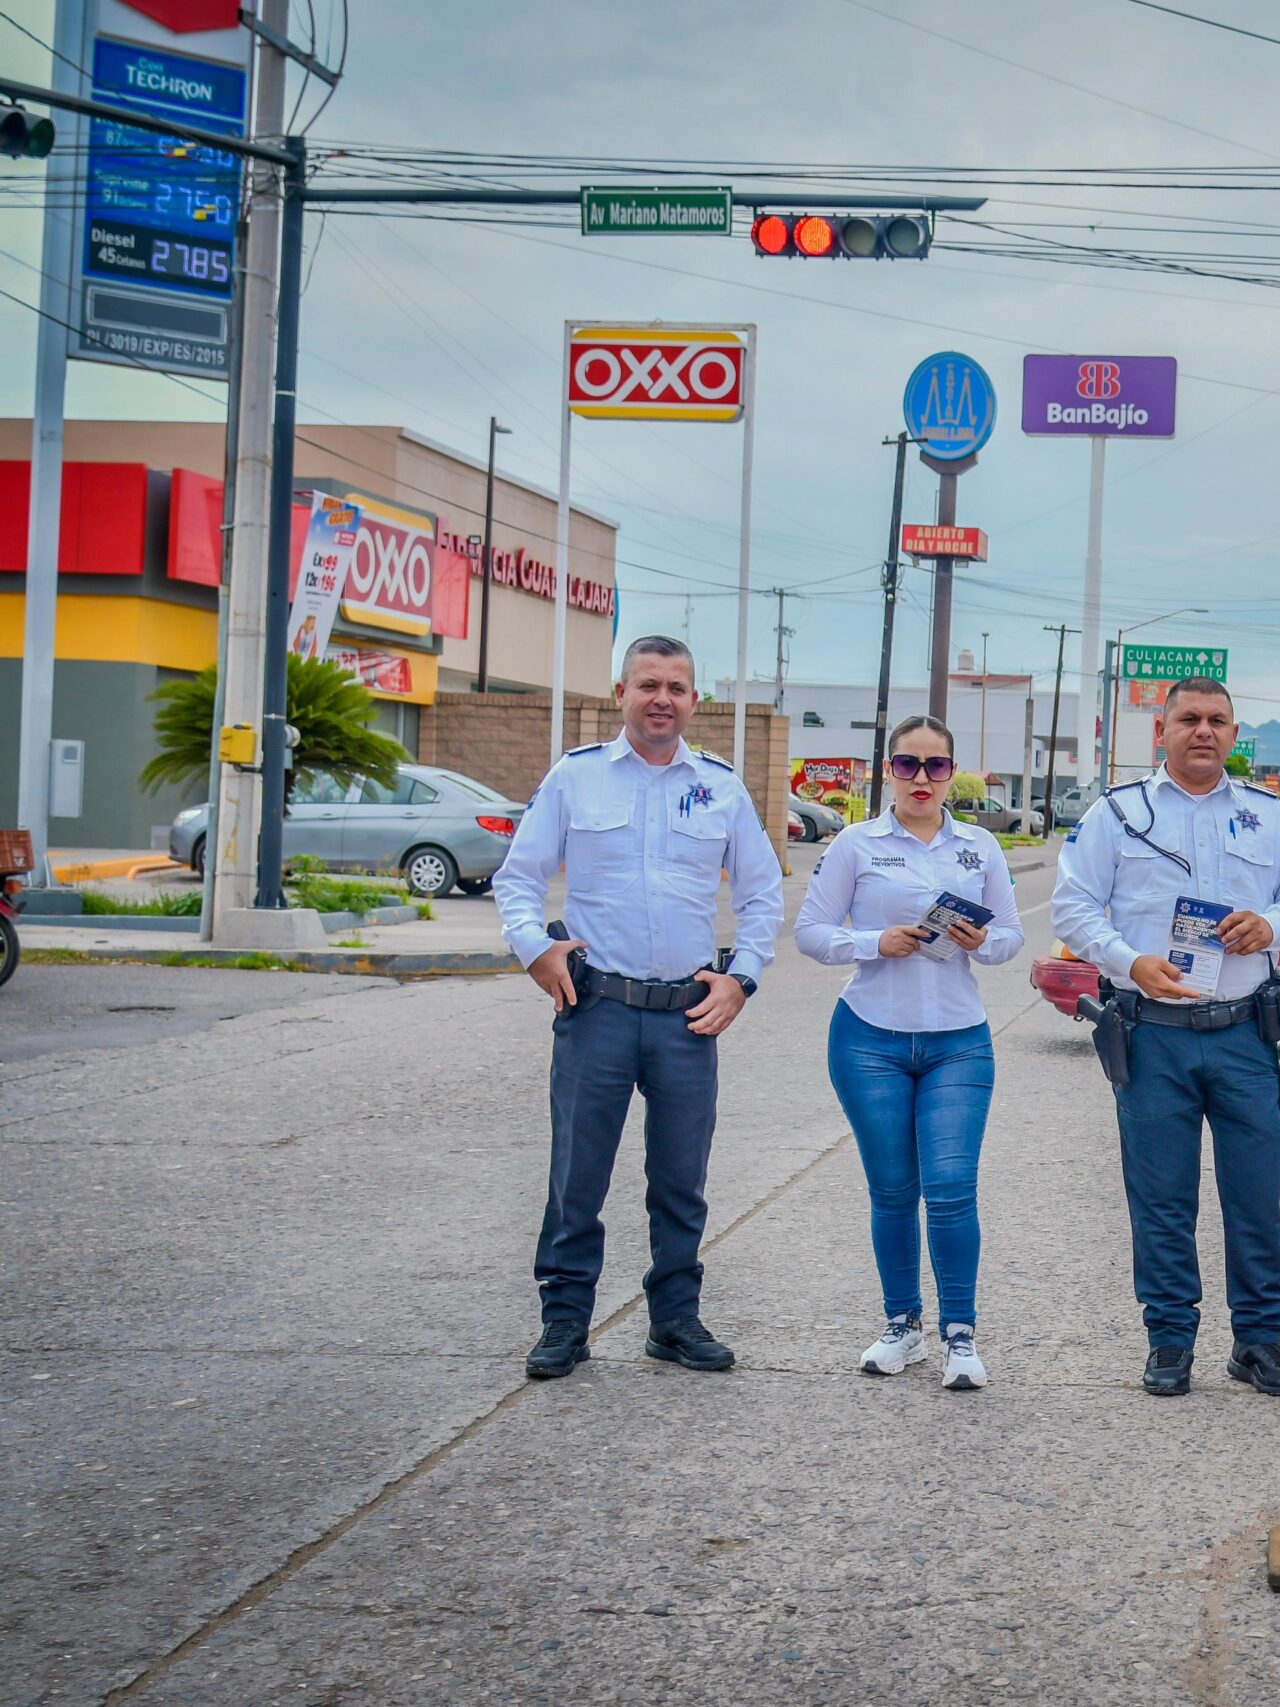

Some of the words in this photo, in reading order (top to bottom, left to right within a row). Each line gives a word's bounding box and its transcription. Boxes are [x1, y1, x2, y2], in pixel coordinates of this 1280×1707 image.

[126, 64, 213, 101] TECHRON
[590, 203, 605, 225] Av
[610, 200, 658, 225] Mariano
[660, 203, 725, 225] Matamoros
[91, 227, 136, 249] Diesel
[98, 246, 117, 265] 45
[574, 346, 738, 402] OXXO
[1046, 403, 1149, 429] BanBajío
[916, 527, 965, 540] ABIERTO
[927, 540, 935, 552] Y
[936, 540, 974, 554] NOCHE
[353, 526, 431, 608] OXXO
[1127, 650, 1193, 662] CULIACAN
[1156, 665, 1223, 678] MOCORITO
[1177, 913, 1201, 922] CUANDO
